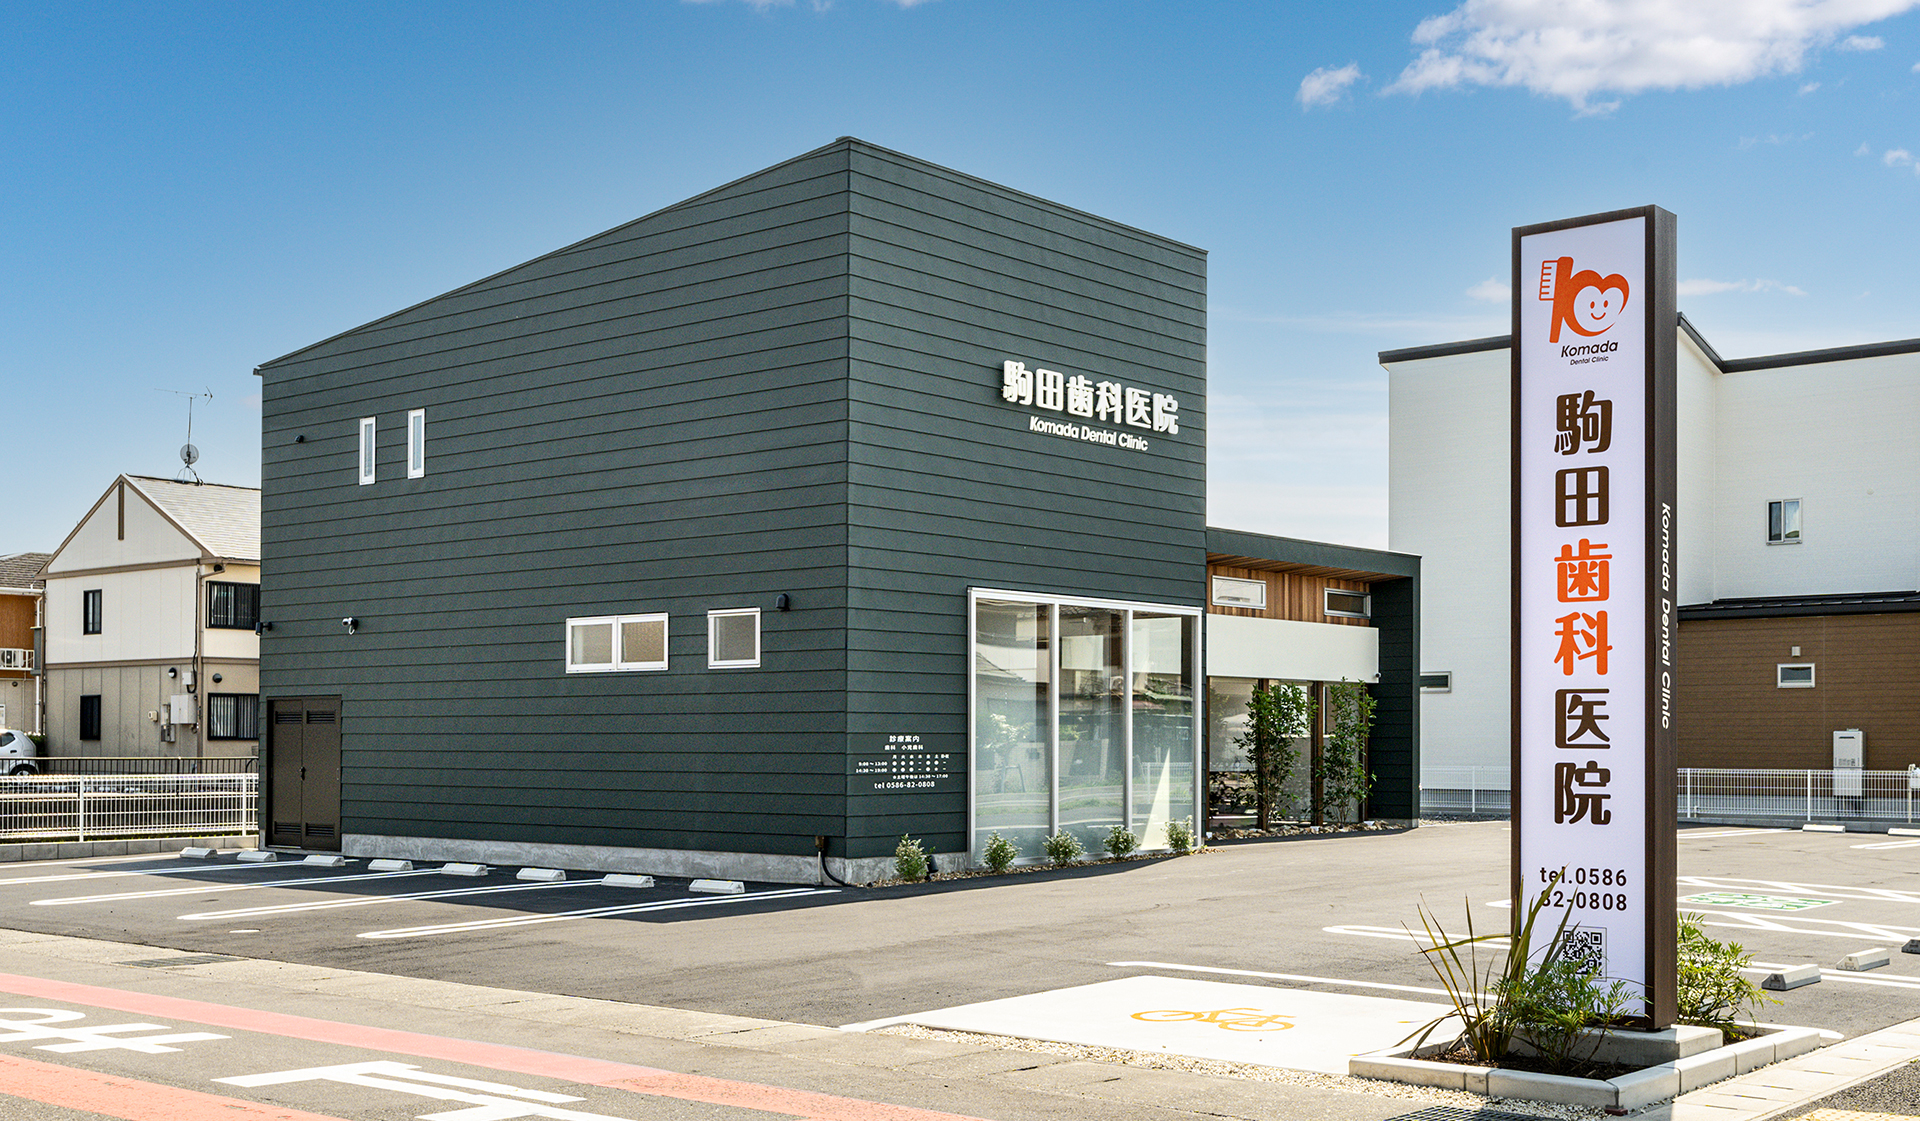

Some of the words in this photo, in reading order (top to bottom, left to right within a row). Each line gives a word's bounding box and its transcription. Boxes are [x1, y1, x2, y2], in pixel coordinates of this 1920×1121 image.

[1561, 340, 1619, 358] Komada
[1570, 357, 1591, 366] Dental
[1591, 355, 1609, 363] Clinic
[1001, 360, 1179, 435] 駒田歯科医院
[1029, 416, 1080, 438] Komada
[1080, 425, 1117, 446] Dental
[1118, 432, 1149, 451] Clinic
[1661, 502, 1671, 592] Komada
[1554, 389, 1613, 826] 駒田歯科医院
[1661, 597, 1671, 667] Dental
[1661, 671, 1671, 730] Clinic
[1540, 866, 1627, 887] tel.0586
